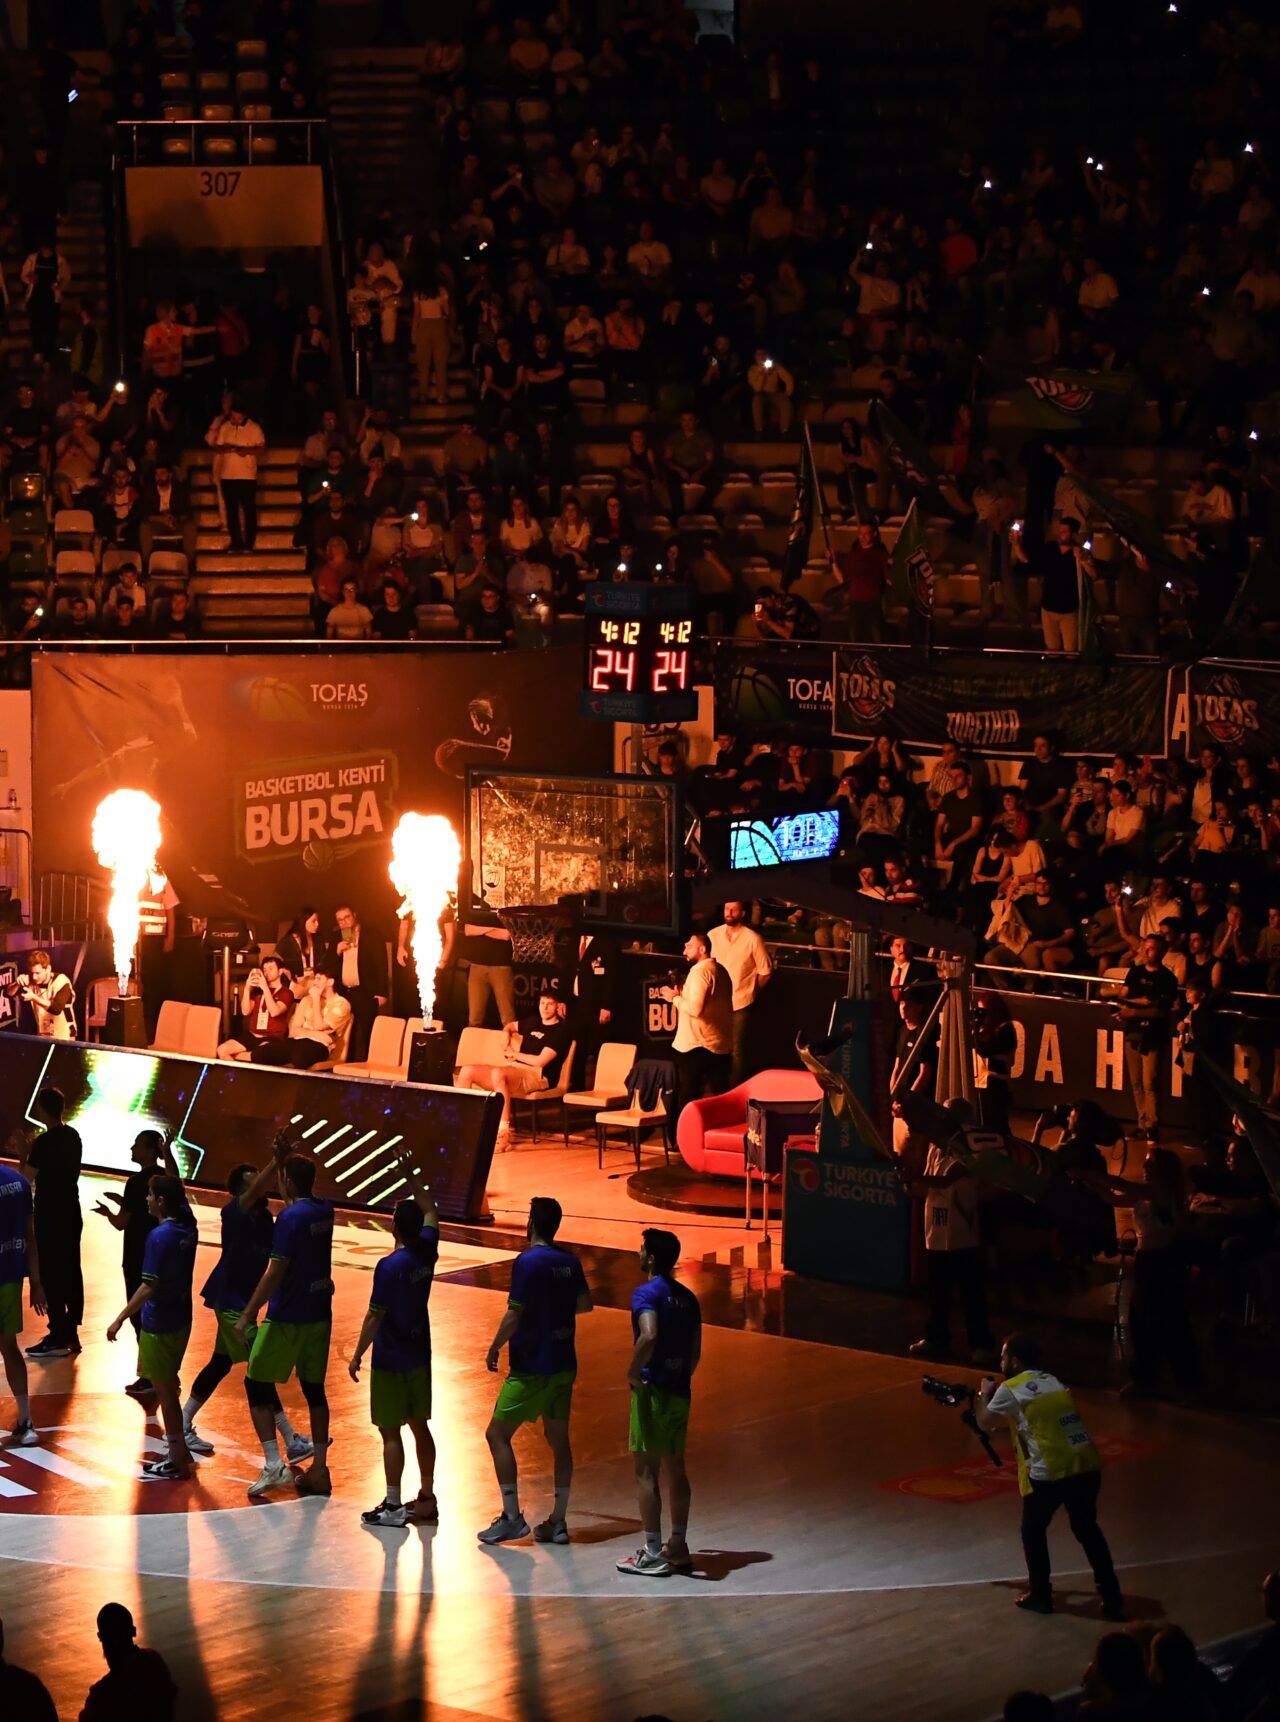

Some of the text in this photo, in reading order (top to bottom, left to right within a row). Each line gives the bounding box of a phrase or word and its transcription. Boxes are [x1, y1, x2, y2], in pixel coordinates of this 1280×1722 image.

[200, 171, 241, 196] 307
[600, 620, 641, 645] 4:12
[660, 620, 692, 644] 4:12
[592, 648, 635, 692] 24
[651, 649, 687, 692] 24
[309, 683, 369, 707] TOFAŞ
[787, 678, 834, 702] TOFA
[945, 708, 1020, 745] TOGETHER
[245, 771, 335, 800] BASKETBOL
[245, 789, 384, 850] BURSA
